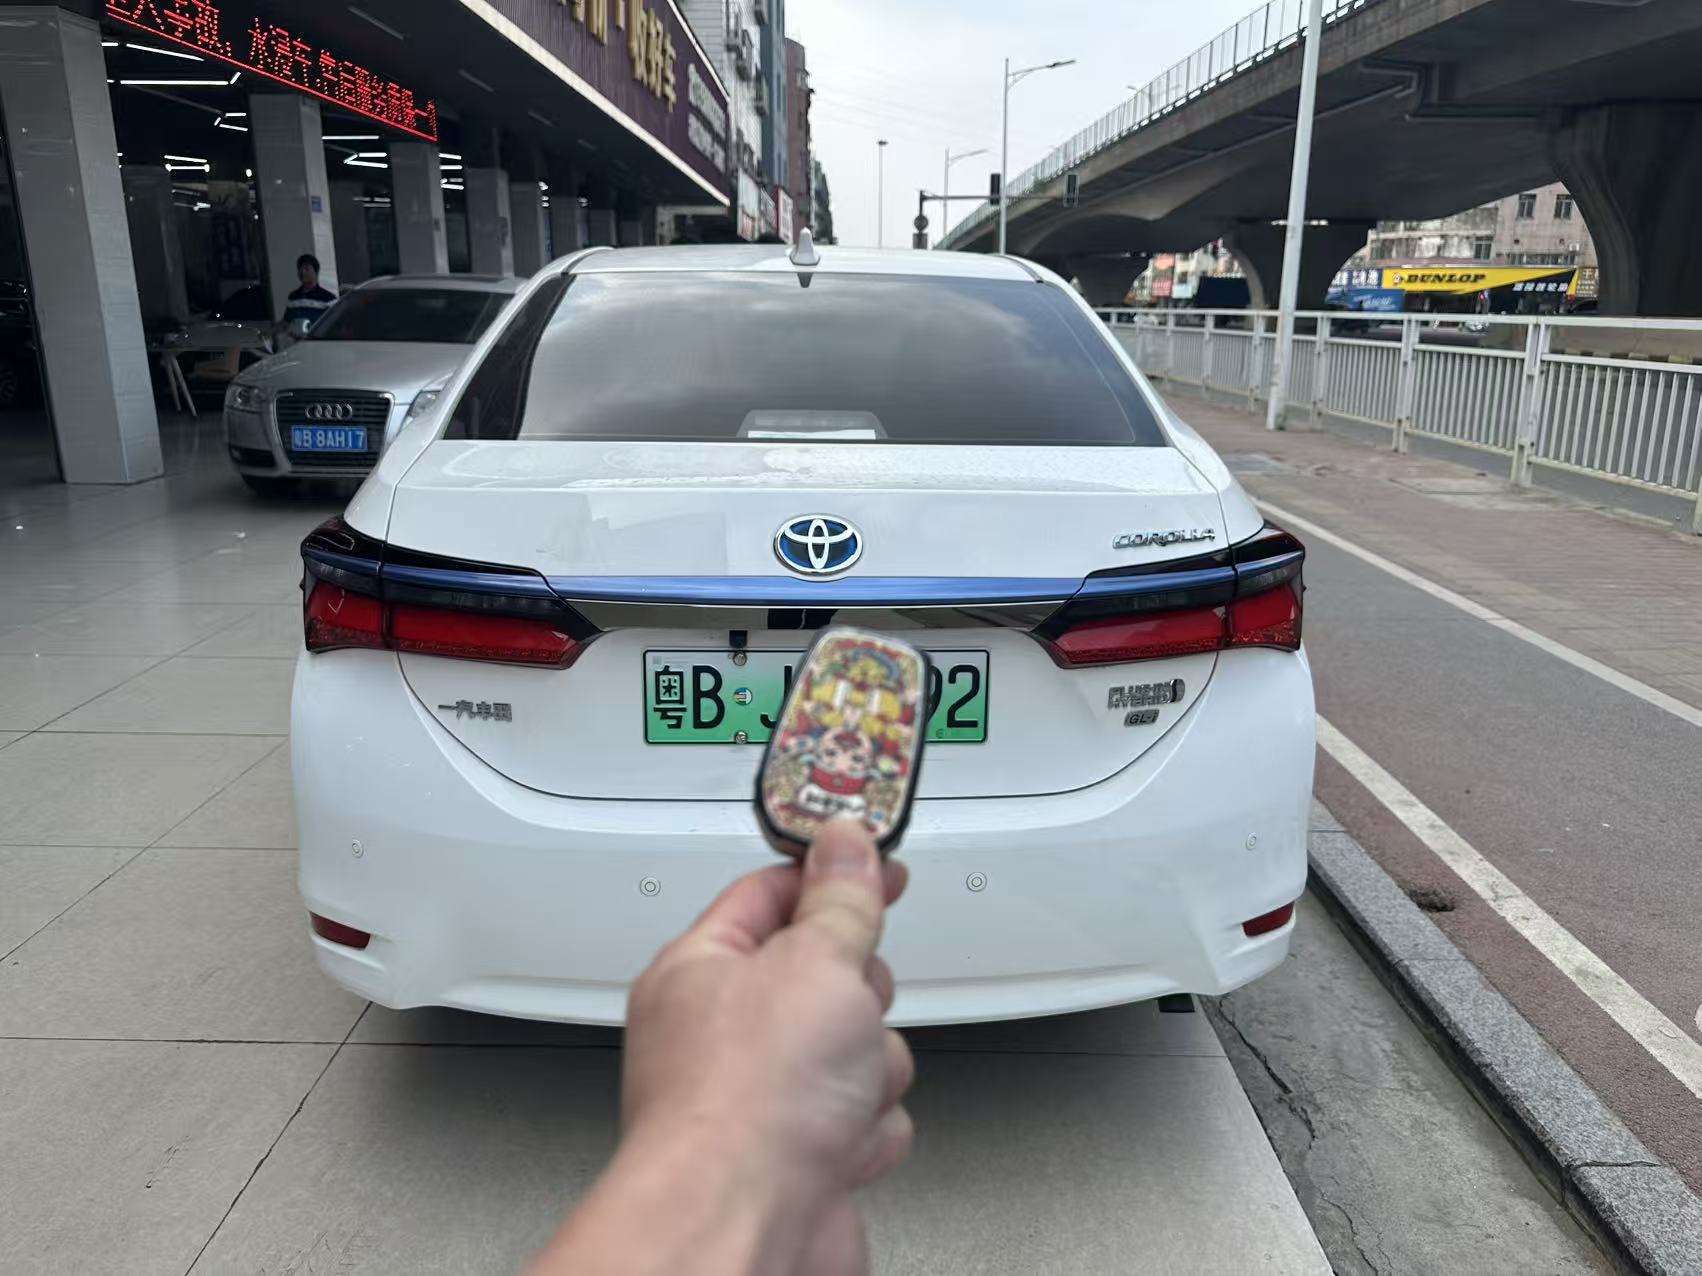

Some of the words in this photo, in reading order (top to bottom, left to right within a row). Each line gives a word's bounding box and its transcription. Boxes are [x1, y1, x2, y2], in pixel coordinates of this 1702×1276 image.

[1406, 274, 1486, 283] DUNLOP
[1112, 528, 1216, 549] COROLLA
[653, 665, 725, 729] 粤B
